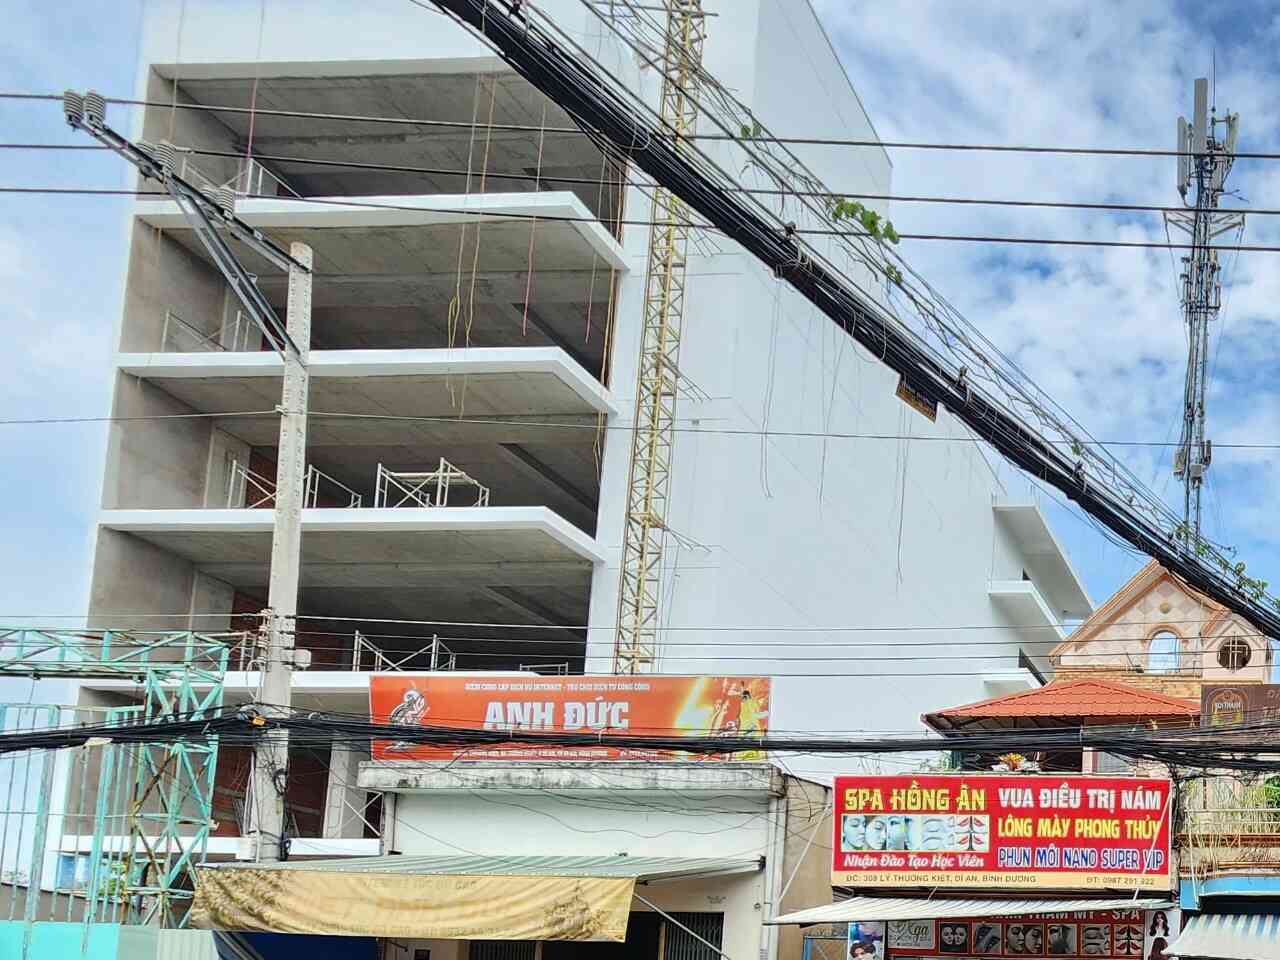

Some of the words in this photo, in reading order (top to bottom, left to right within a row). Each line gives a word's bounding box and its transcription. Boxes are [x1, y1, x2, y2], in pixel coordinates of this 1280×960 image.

[483, 701, 554, 730] ANH
[563, 696, 630, 730] ĐỨC
[845, 788, 884, 811] SPA
[890, 780, 950, 811] HỒNG
[998, 788, 1035, 809] VUA
[1039, 782, 1081, 809] ĐIỀU
[1087, 788, 1116, 813] TRỊ
[1121, 786, 1161, 811] NÁM
[998, 814, 1033, 838] LÔNG
[1037, 814, 1072, 838] MÀY
[1075, 818, 1121, 839] PHONG
[1125, 815, 1162, 840] THỦY
[844, 854, 878, 869] Nhận
[880, 853, 905, 867] Đào
[907, 853, 928, 869] Tạo
[931, 854, 955, 869] Học
[958, 853, 985, 868] Viên
[998, 847, 1031, 868] PHUN
[1034, 843, 1060, 868] MÔI
[1063, 848, 1098, 868] NANO
[1101, 848, 1140, 870] SUPER
[1143, 848, 1165, 870] VIP
